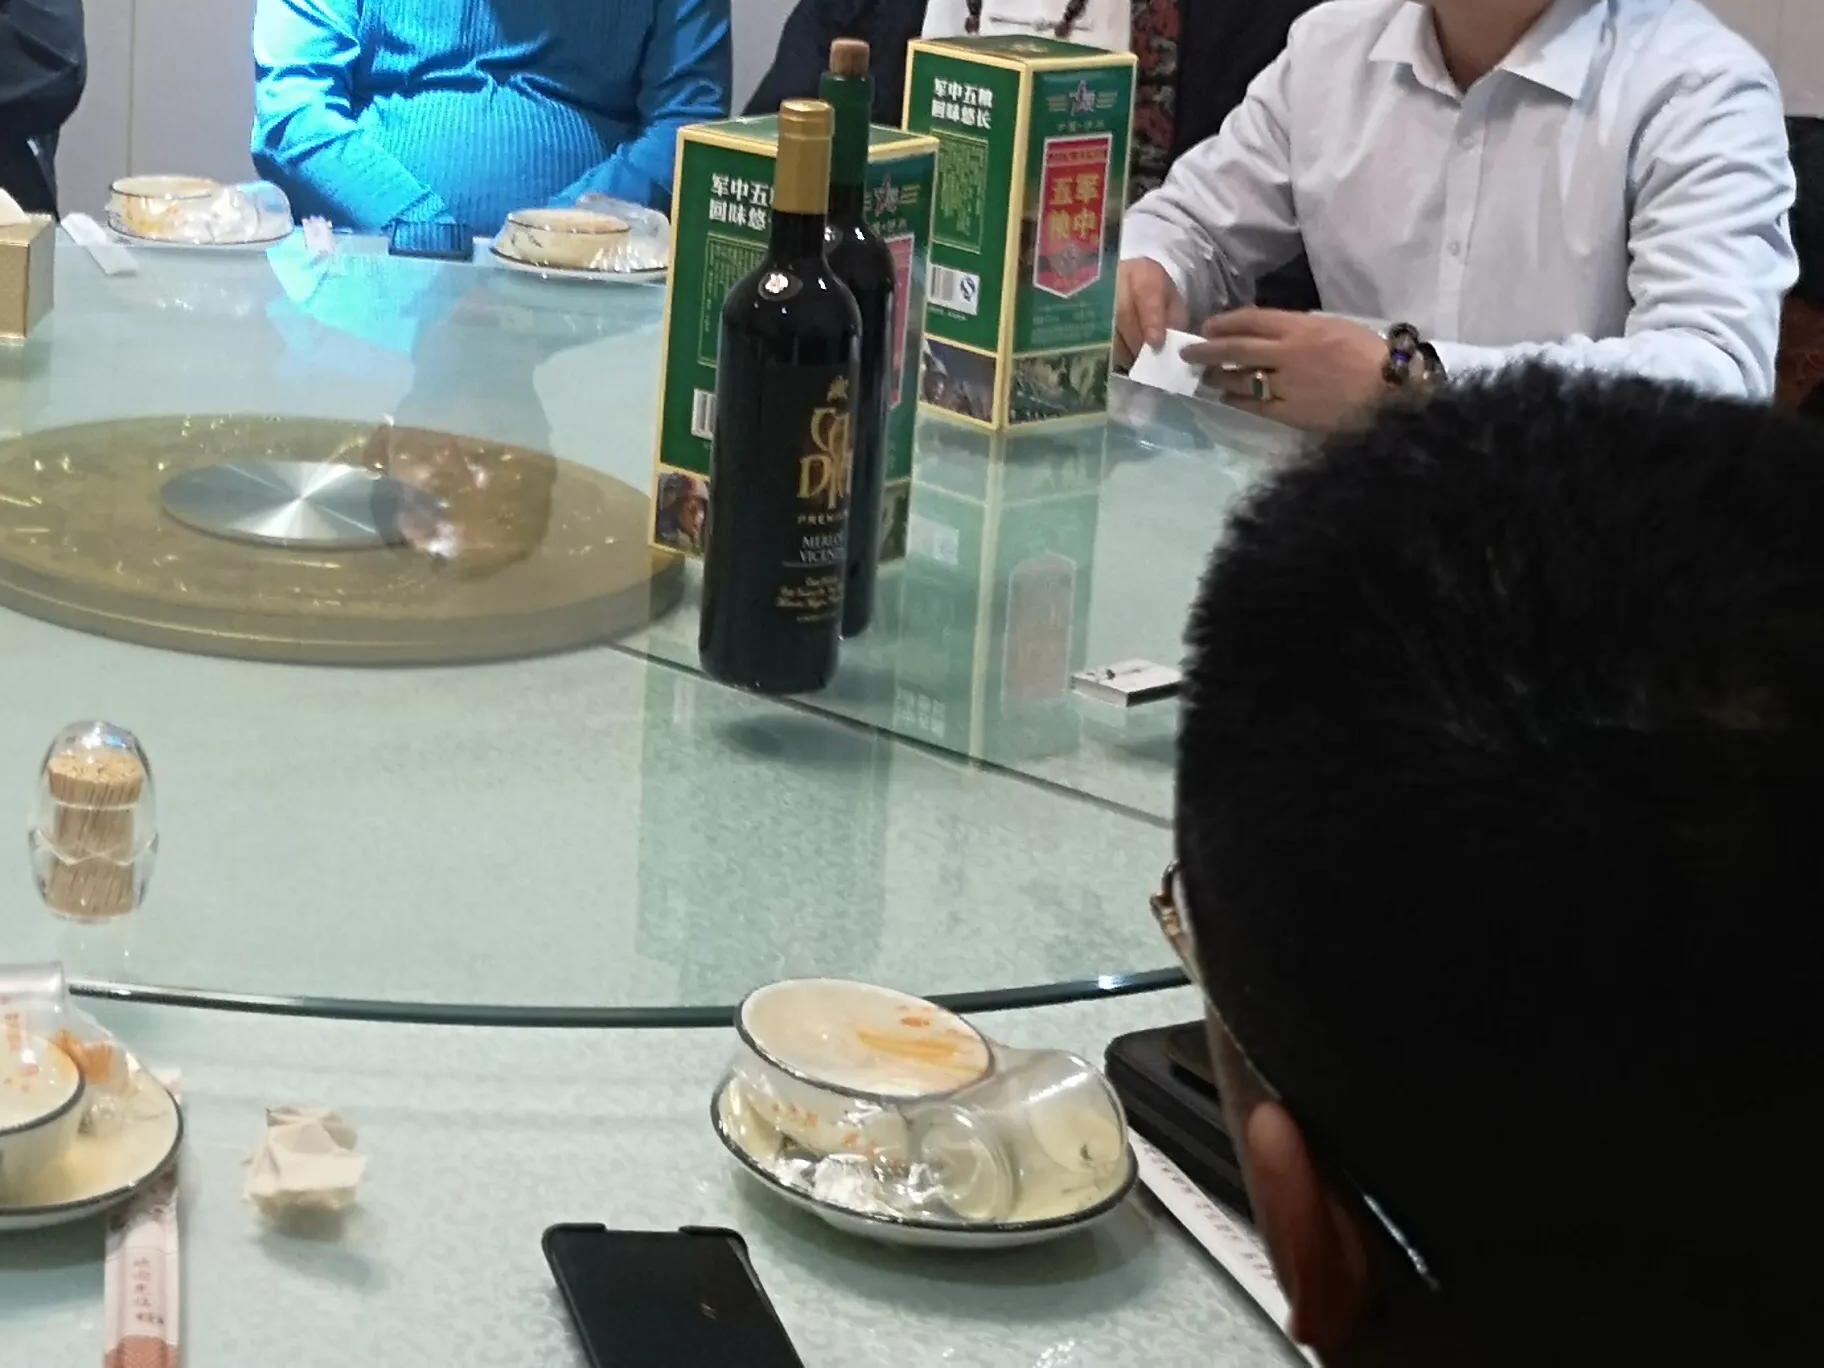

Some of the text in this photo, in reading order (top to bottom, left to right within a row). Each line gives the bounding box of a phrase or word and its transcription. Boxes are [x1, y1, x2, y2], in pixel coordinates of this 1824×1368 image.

[931, 98, 992, 130] 回味悠长
[711, 173, 775, 208] 军中五
[709, 198, 773, 231] 回味悠
